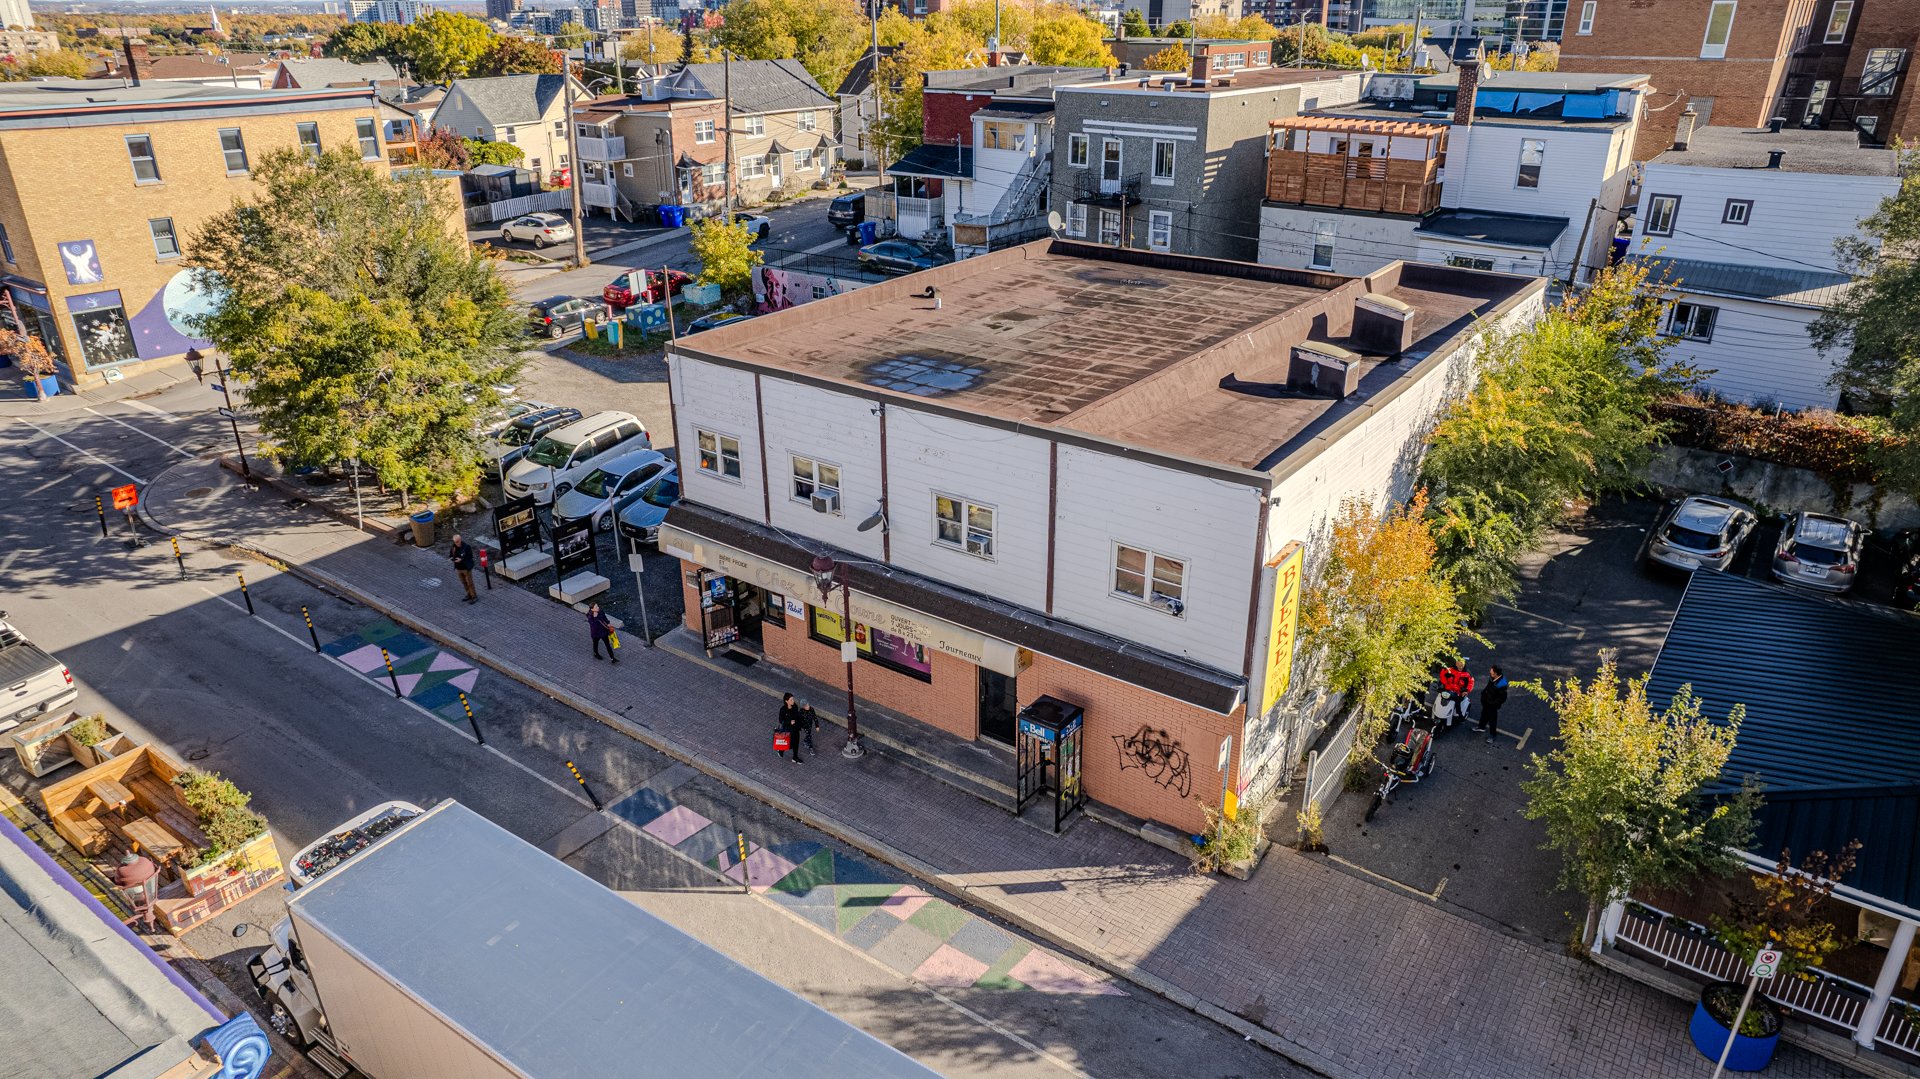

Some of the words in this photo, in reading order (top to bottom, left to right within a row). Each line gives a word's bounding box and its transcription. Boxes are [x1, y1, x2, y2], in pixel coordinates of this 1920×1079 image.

[786, 601, 803, 615] Pabst
[890, 614, 912, 626] OUVERT
[895, 622, 914, 633] JOURS
[939, 640, 982, 663] Journeaux
[1030, 723, 1045, 737] Bell
